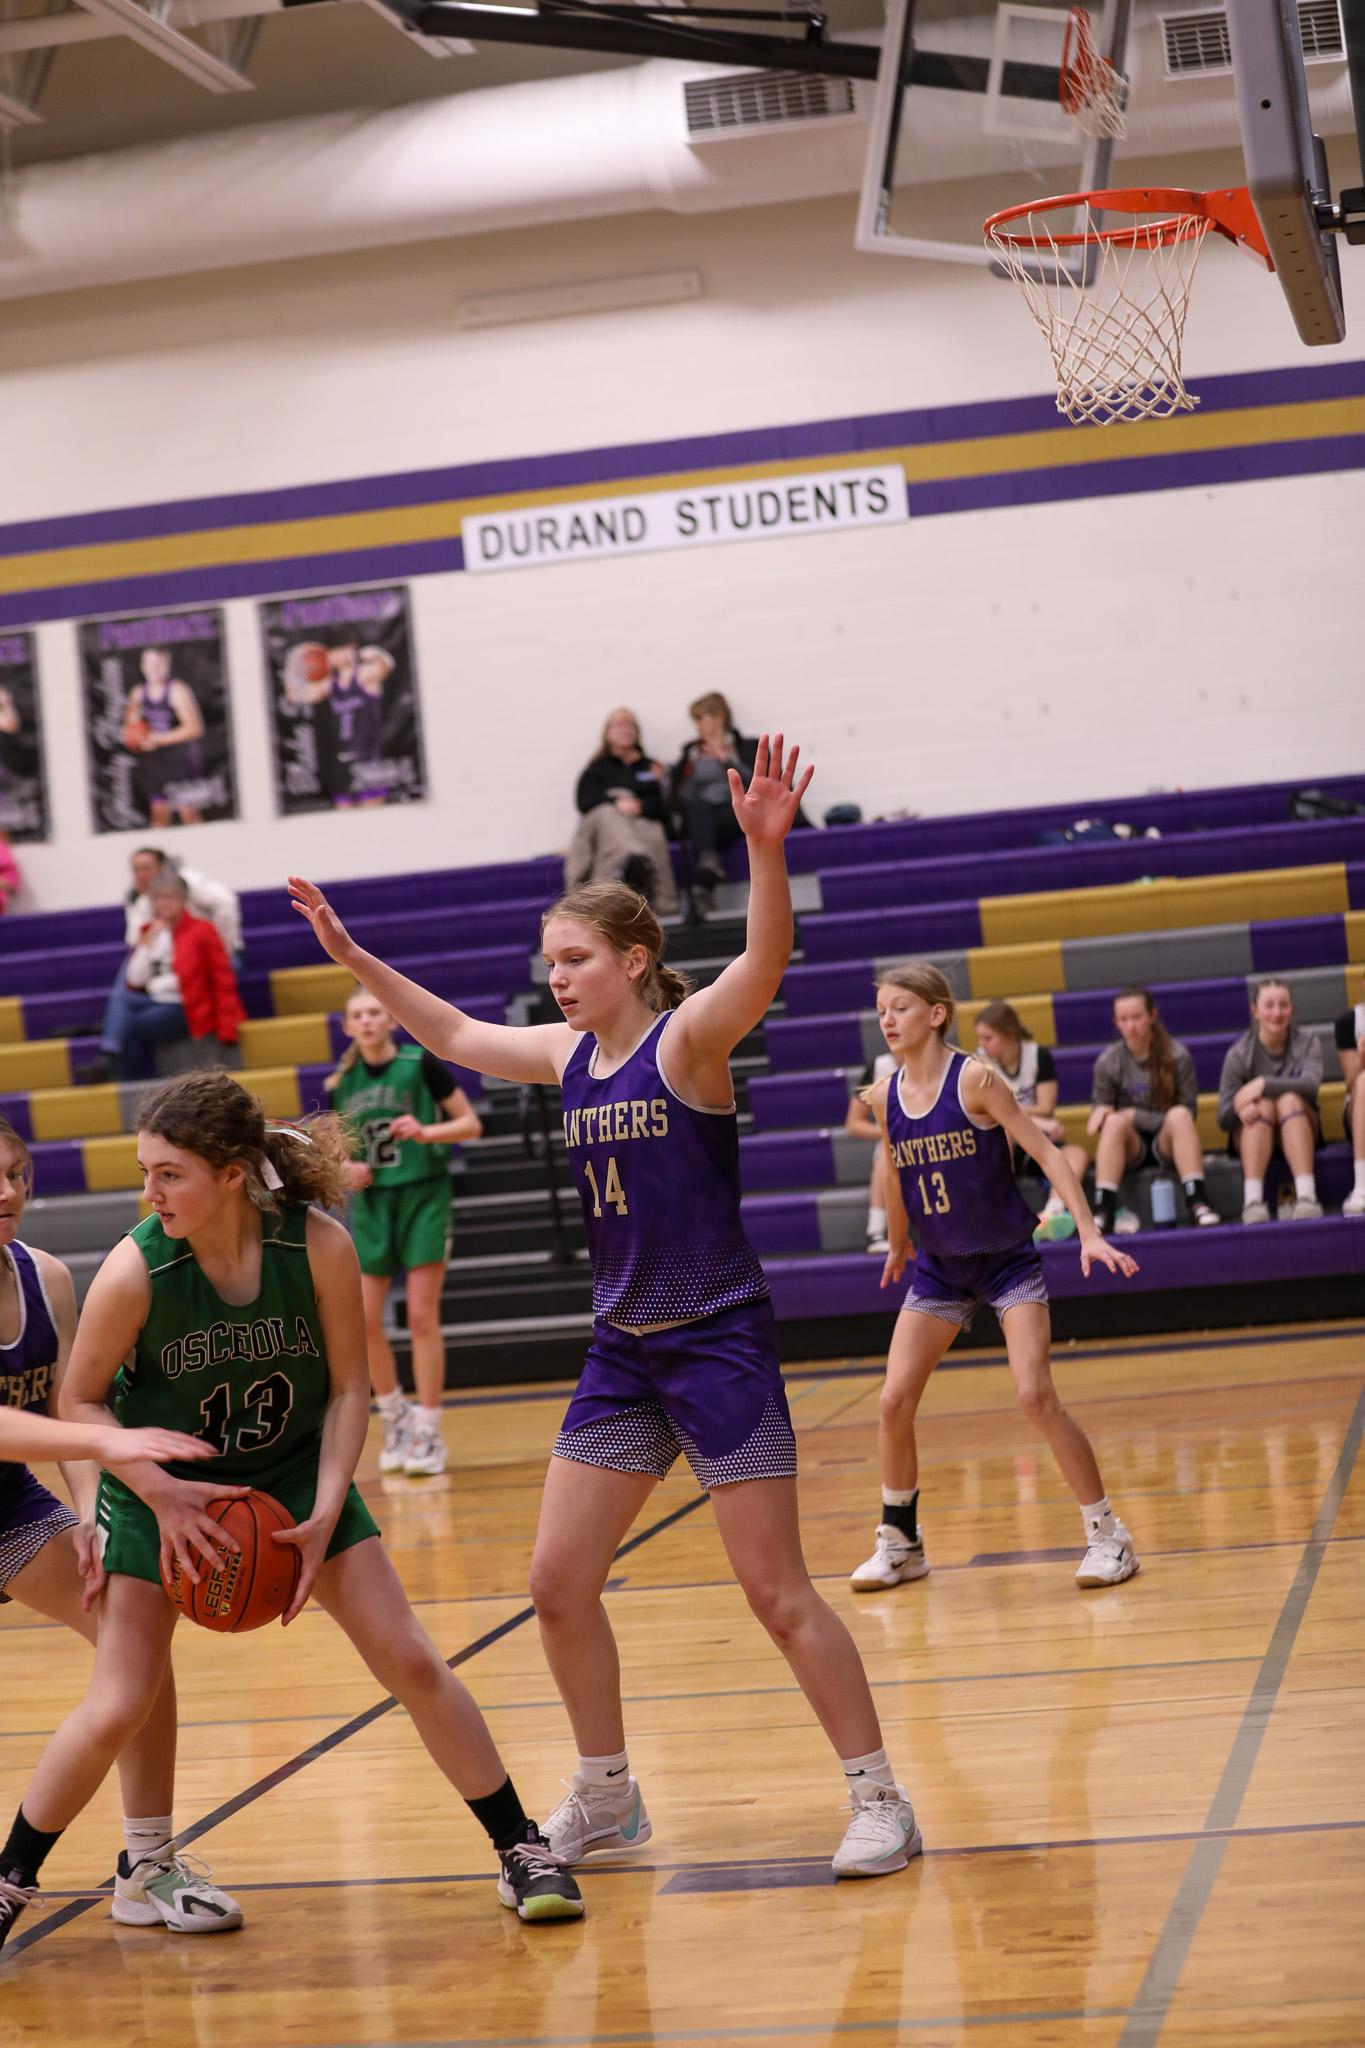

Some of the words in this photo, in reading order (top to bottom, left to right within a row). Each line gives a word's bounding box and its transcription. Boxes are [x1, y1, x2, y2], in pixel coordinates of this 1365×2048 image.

[480, 507, 646, 560] DURAND
[677, 479, 888, 536] STUDENTS
[584, 1157, 628, 1218] 14
[918, 1172, 951, 1215] 13
[161, 1317, 319, 1379] OSCEOLA
[193, 1371, 293, 1457] 13
